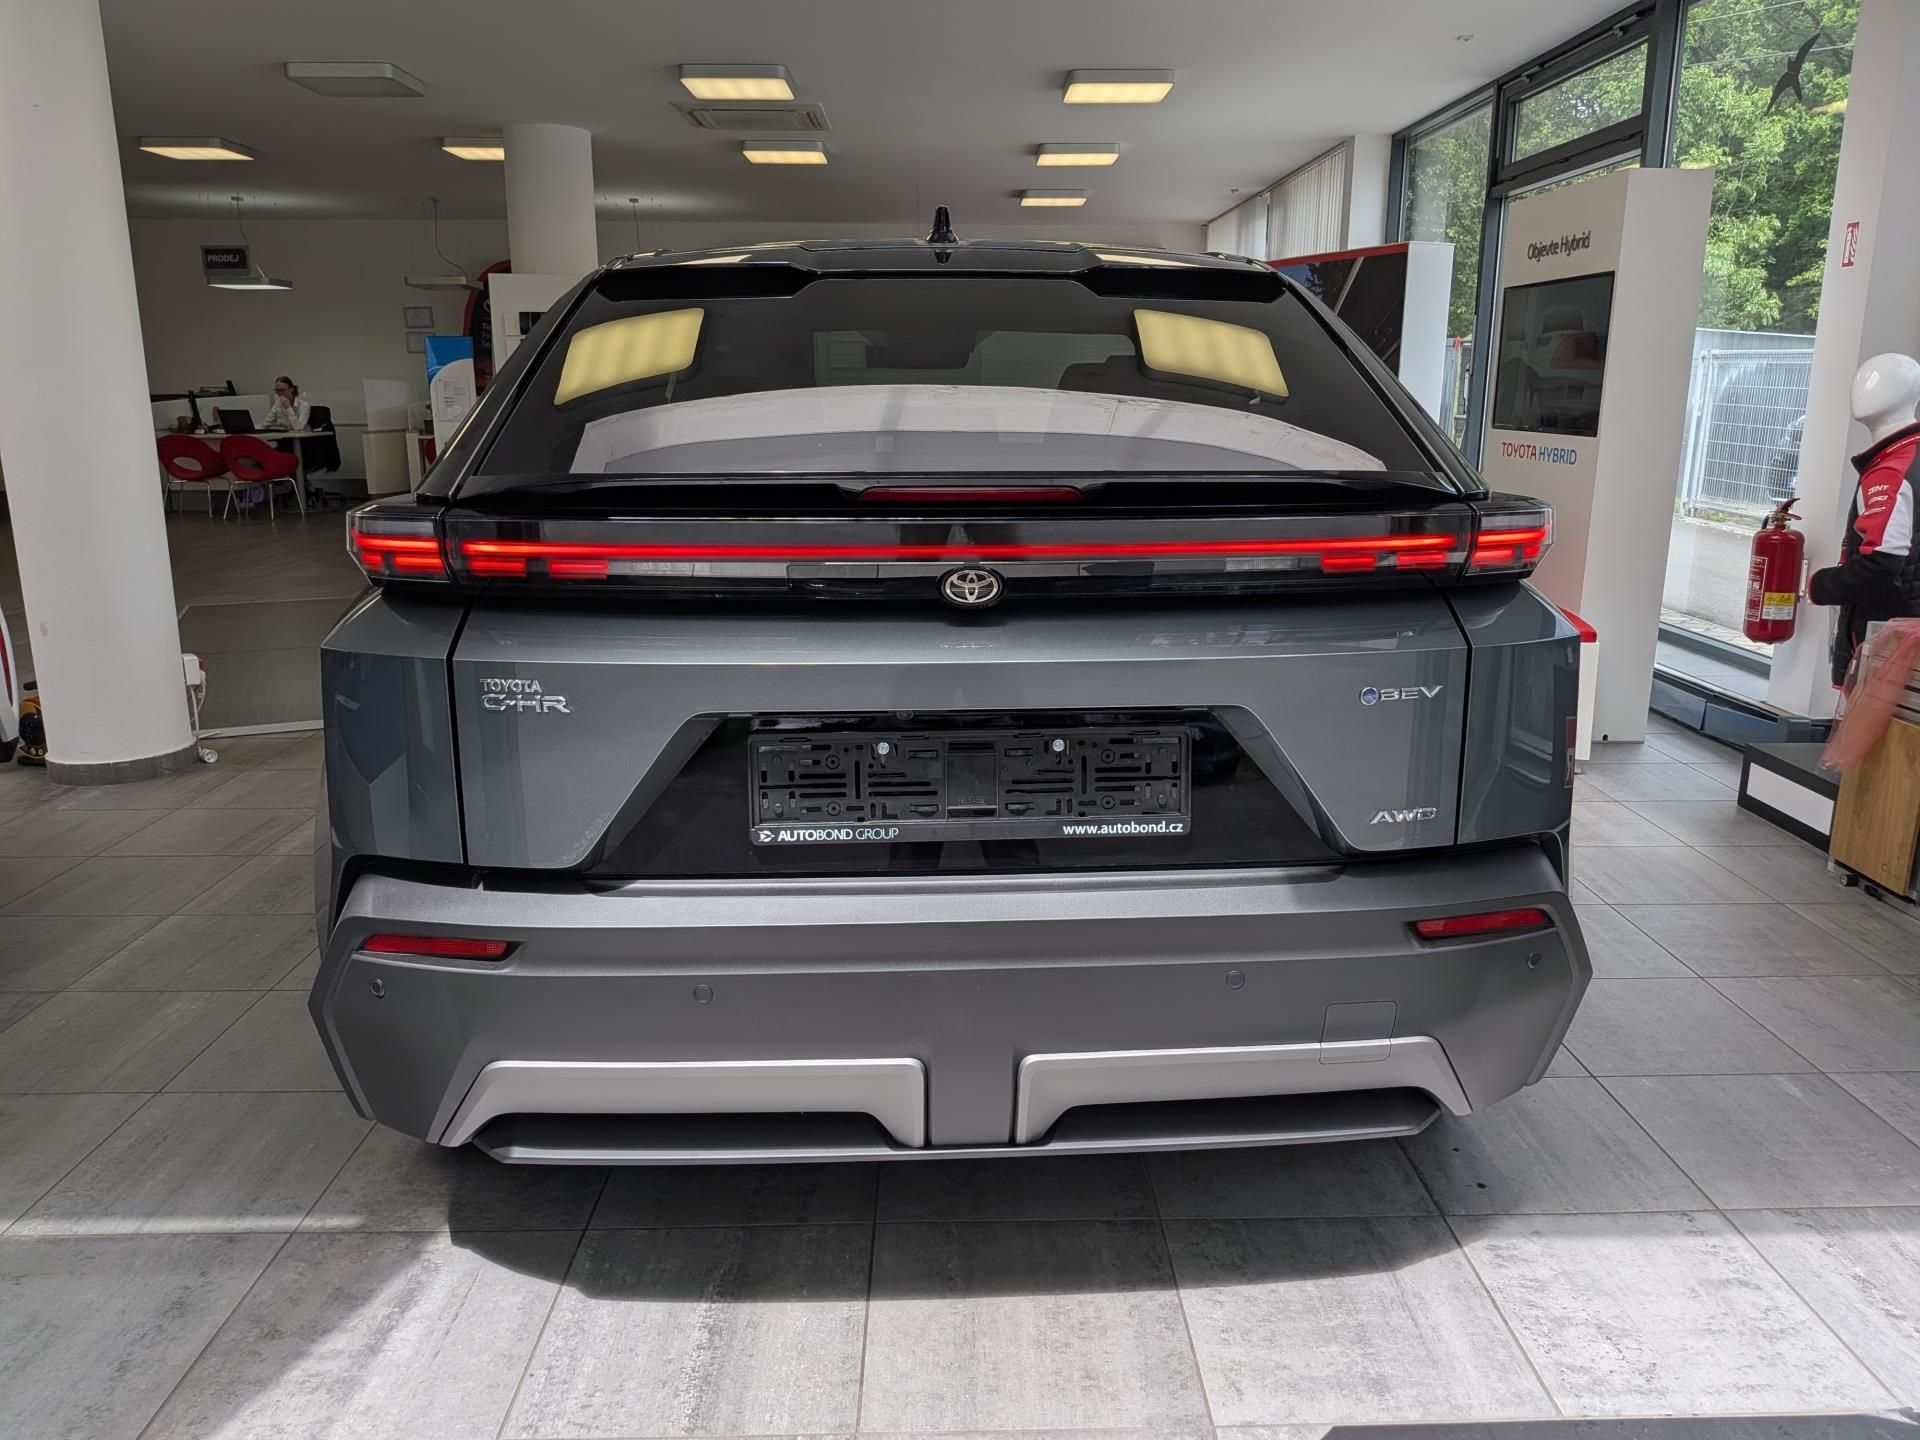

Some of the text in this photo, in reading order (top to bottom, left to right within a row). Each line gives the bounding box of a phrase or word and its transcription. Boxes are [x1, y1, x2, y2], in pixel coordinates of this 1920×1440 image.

[1527, 230, 1592, 262] Objevte Hybrid
[207, 254, 240, 263] PRODEJ
[1501, 441, 1577, 465] TOYOTA HYBRID
[479, 678, 543, 693] TOYOTA
[1380, 685, 1443, 701] BEV
[481, 693, 571, 713] C-HR
[1369, 807, 1437, 825] AWD
[777, 827, 899, 841] AUTOBOND GROUP
[1062, 820, 1184, 835] www.autobond.cz
